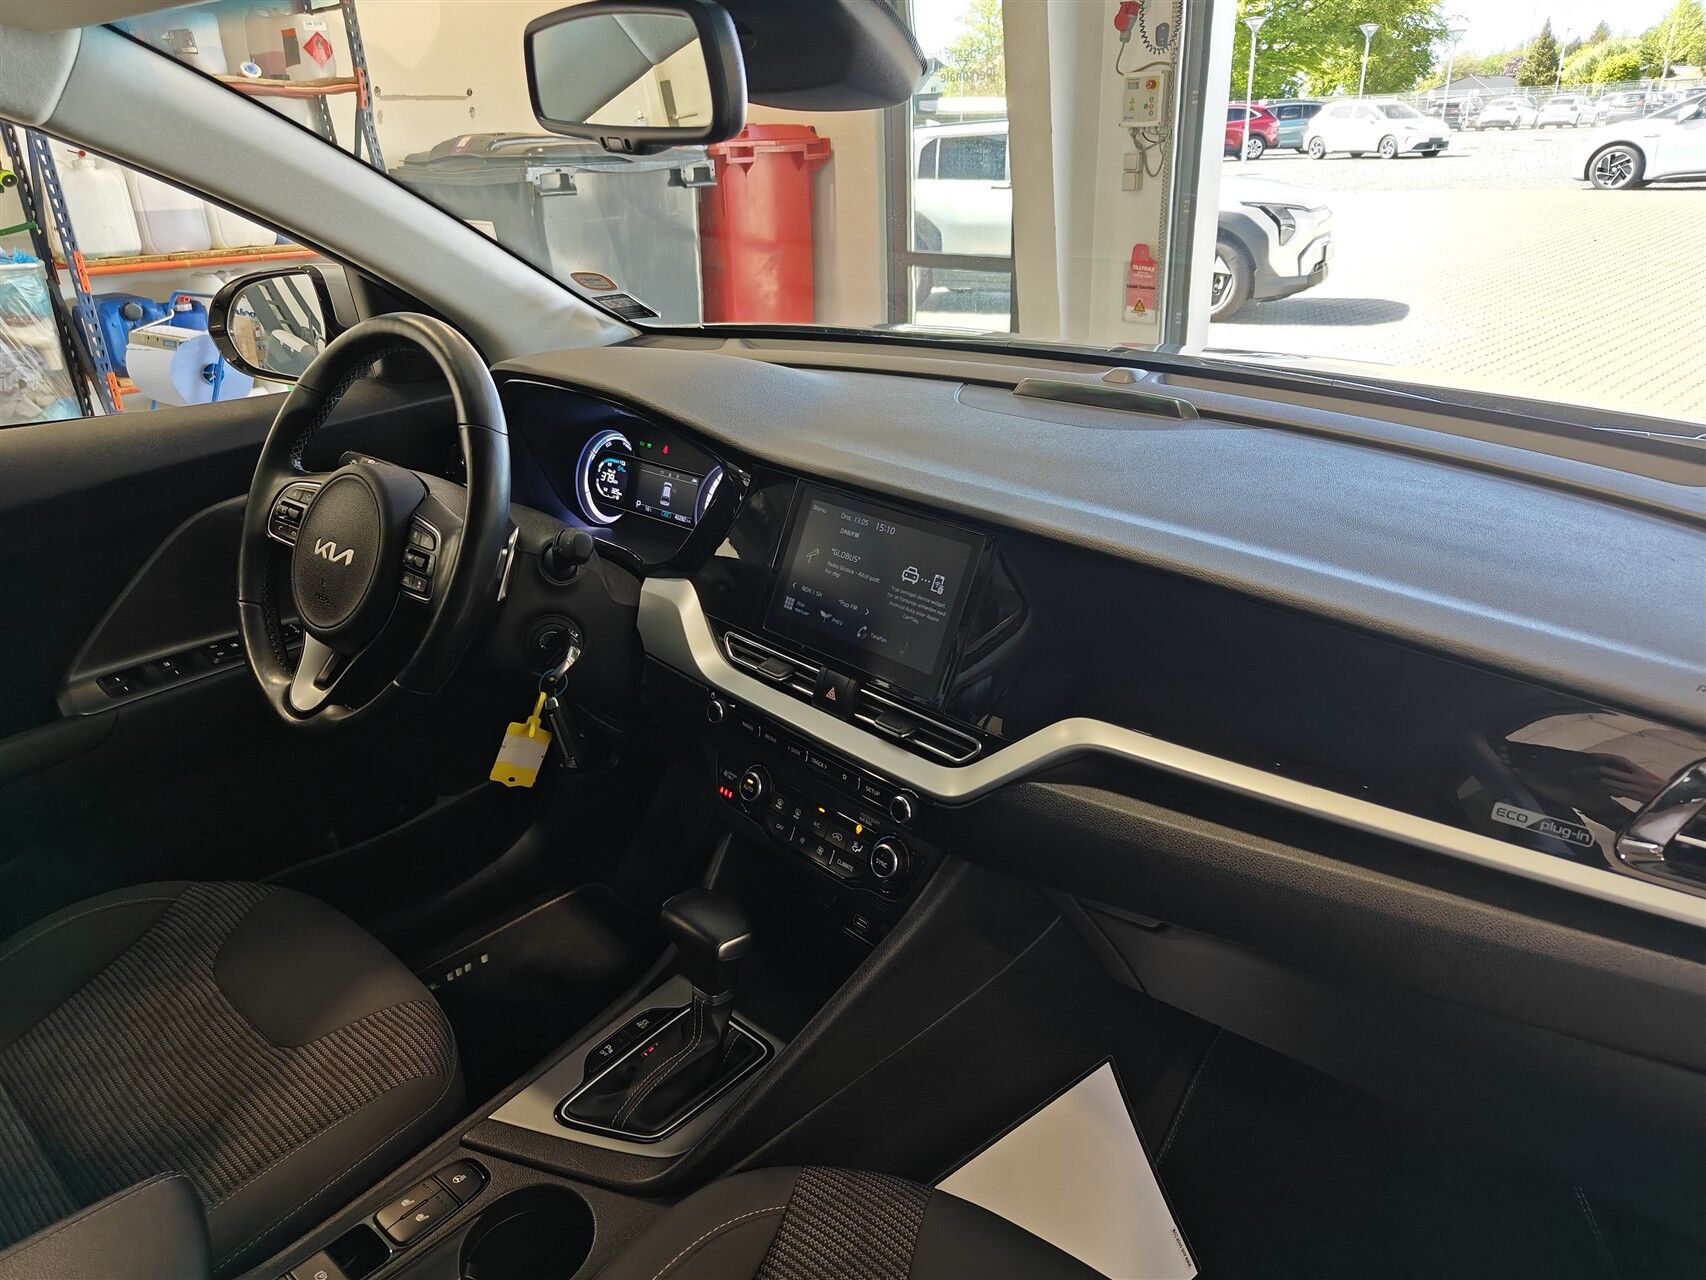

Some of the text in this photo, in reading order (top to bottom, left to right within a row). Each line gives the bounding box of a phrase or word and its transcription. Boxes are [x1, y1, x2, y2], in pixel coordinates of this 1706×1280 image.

[876, 522, 896, 536] 15:10
[314, 538, 354, 566] KIA
[865, 786, 880, 796] SETUP
[1496, 807, 1590, 842] ECO plug-in
